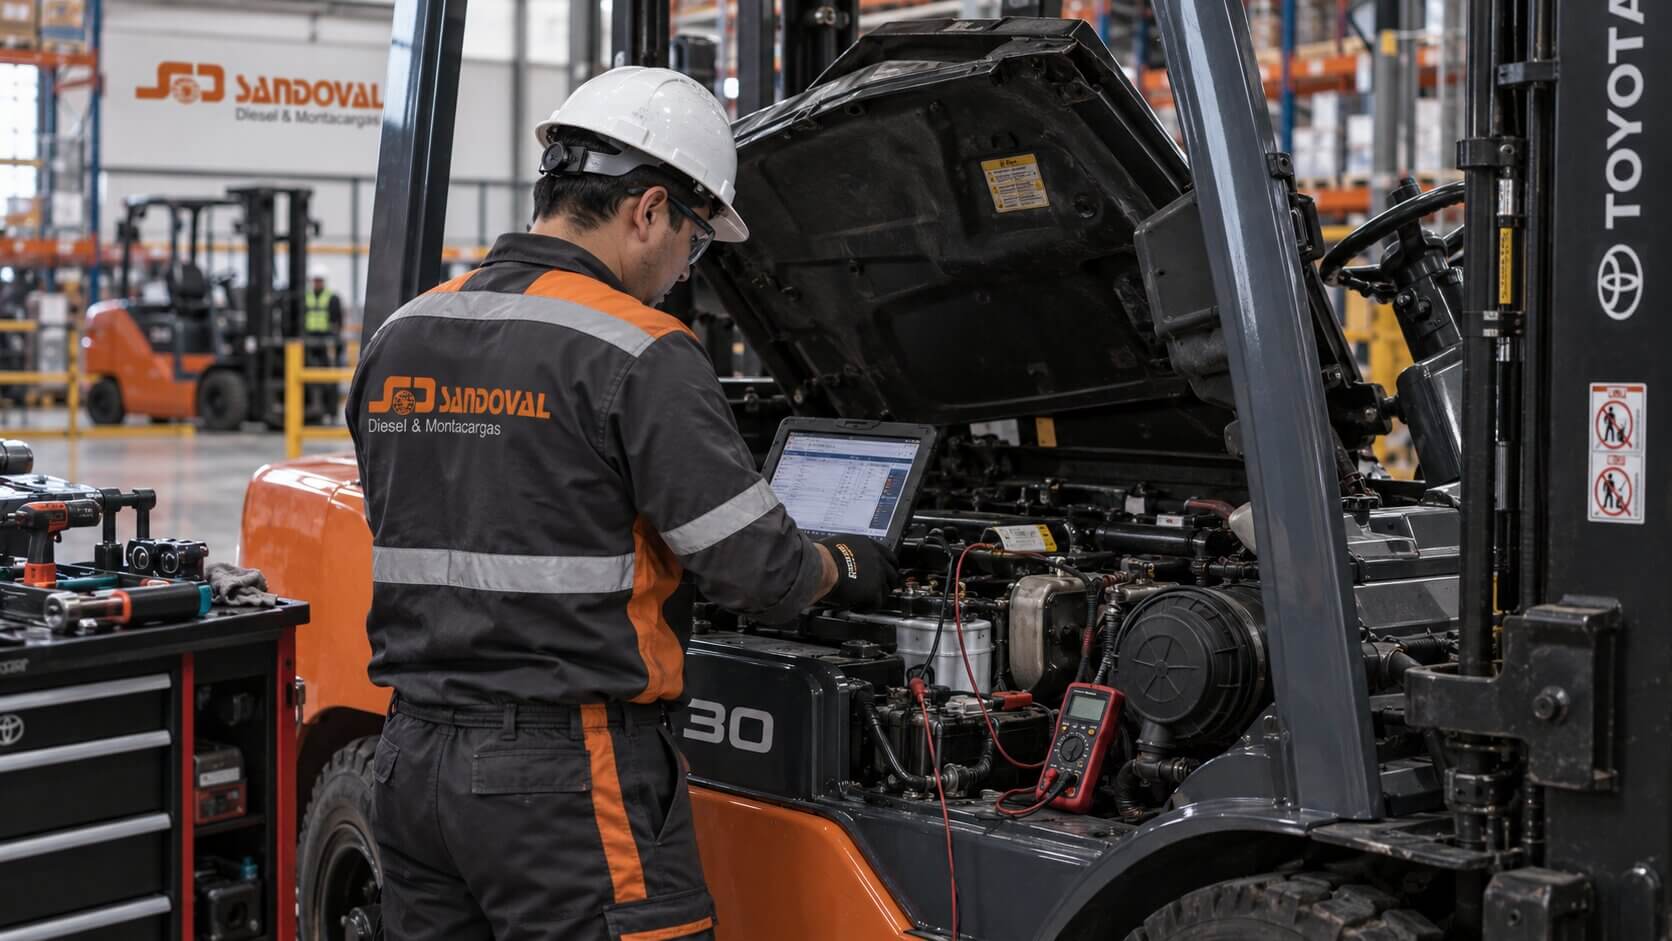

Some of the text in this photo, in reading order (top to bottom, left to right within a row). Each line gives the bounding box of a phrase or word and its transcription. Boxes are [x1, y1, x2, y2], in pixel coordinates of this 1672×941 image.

[235, 74, 384, 109] SANDOVAL
[235, 107, 380, 128] Diesel & Montacargas
[1605, 0, 1645, 230] TOYOTA
[439, 386, 551, 419] SANDOVAL
[368, 418, 501, 438] Diesel & Montacargas
[683, 698, 774, 753] 30
